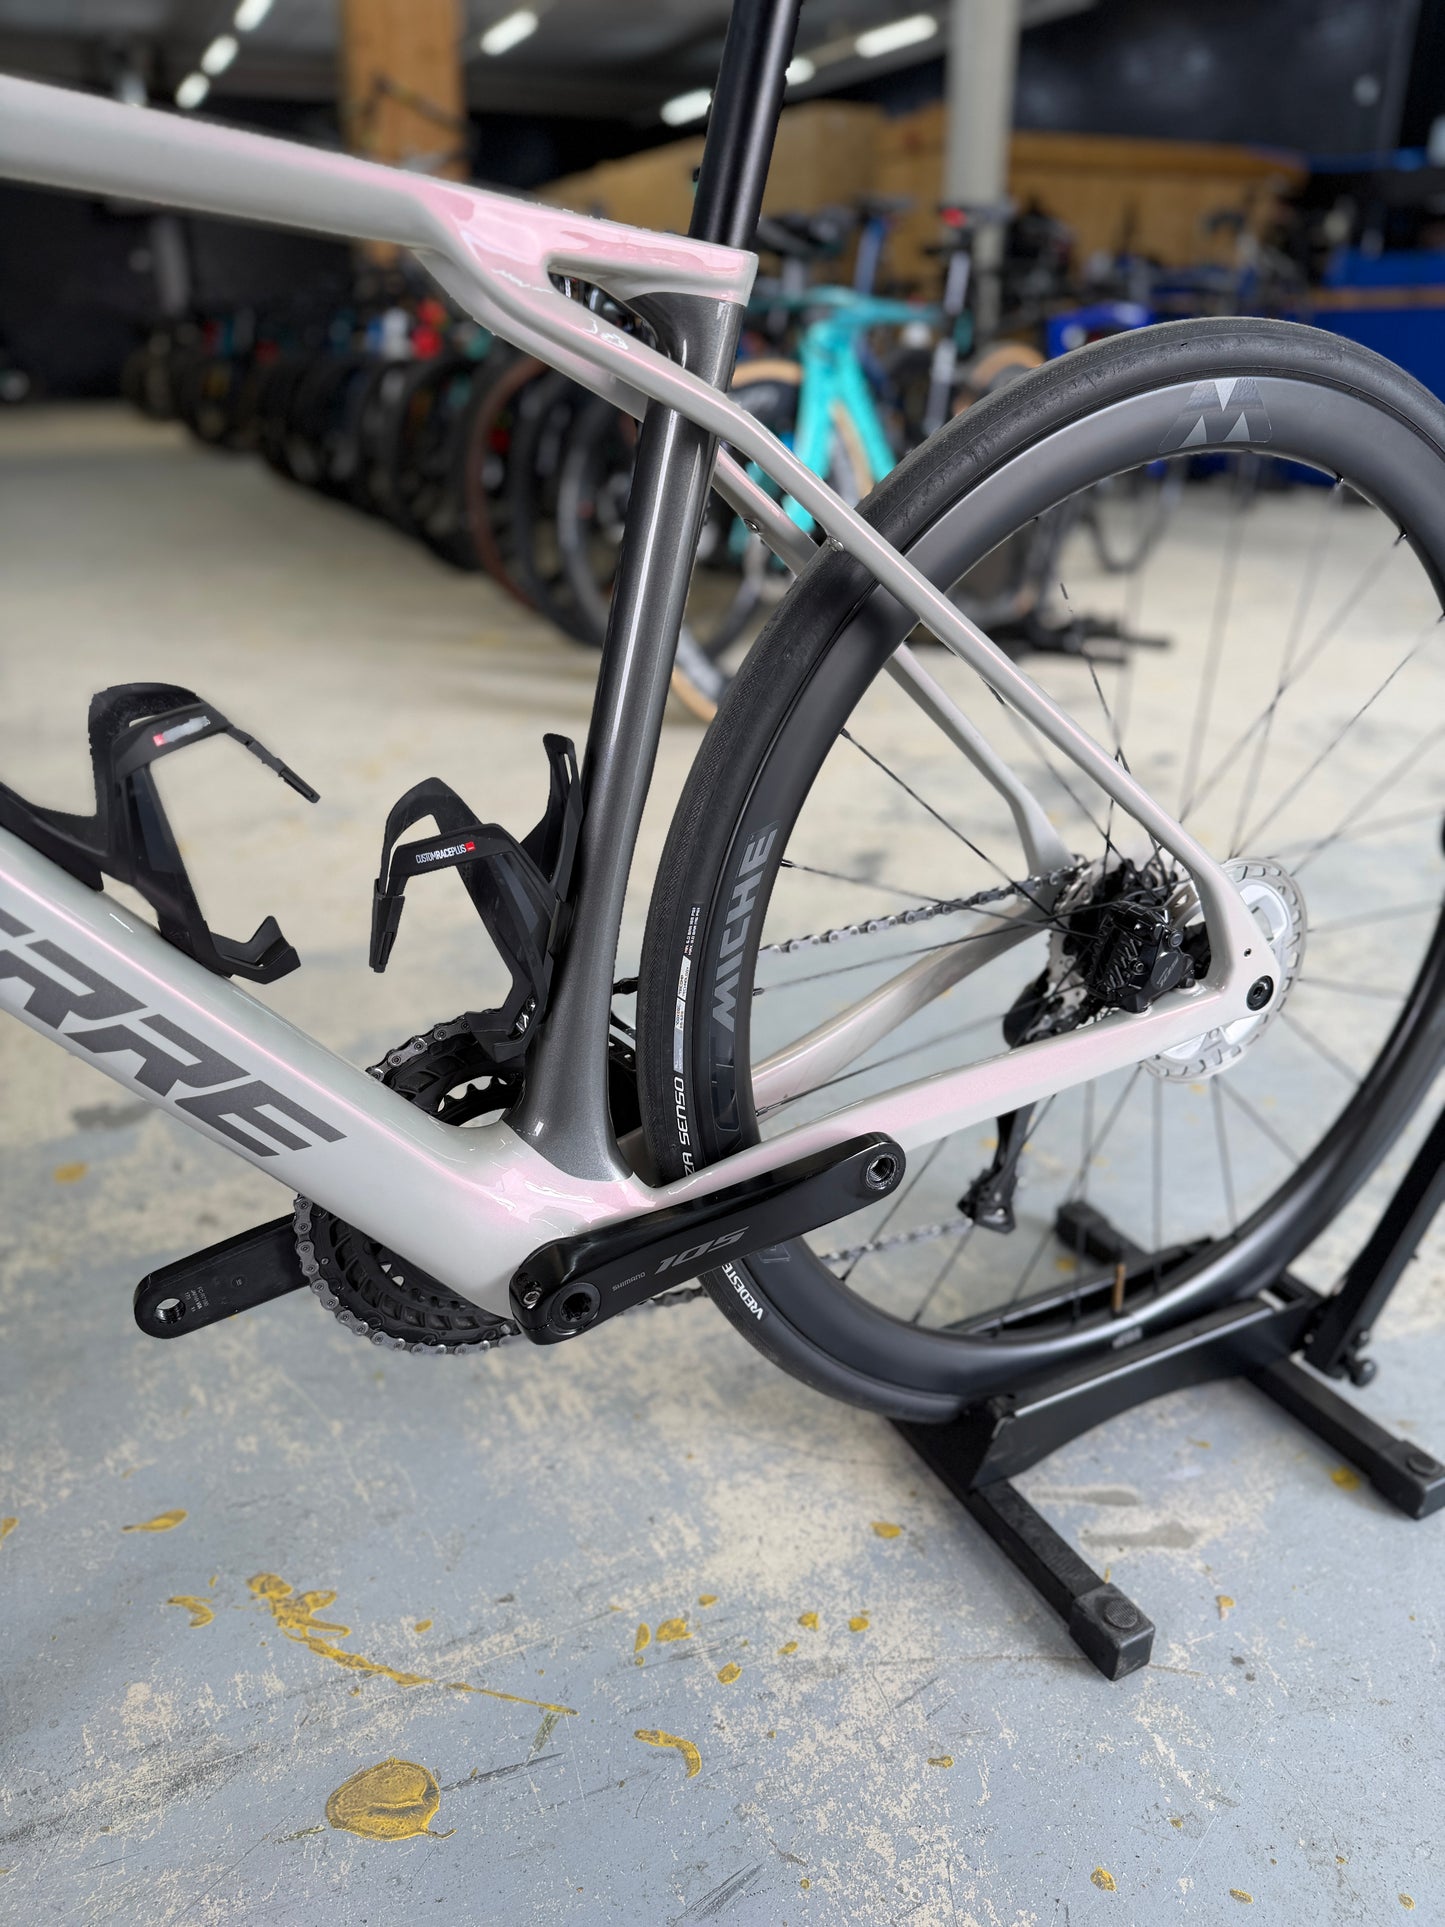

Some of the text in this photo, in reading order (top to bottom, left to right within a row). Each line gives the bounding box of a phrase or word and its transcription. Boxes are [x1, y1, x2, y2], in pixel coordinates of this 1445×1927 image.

[712, 828, 778, 1032] MICHE
[0, 906, 347, 1157] RRE
[674, 1076, 690, 1145] SENSO
[612, 1225, 750, 1292] SHIMANO 105
